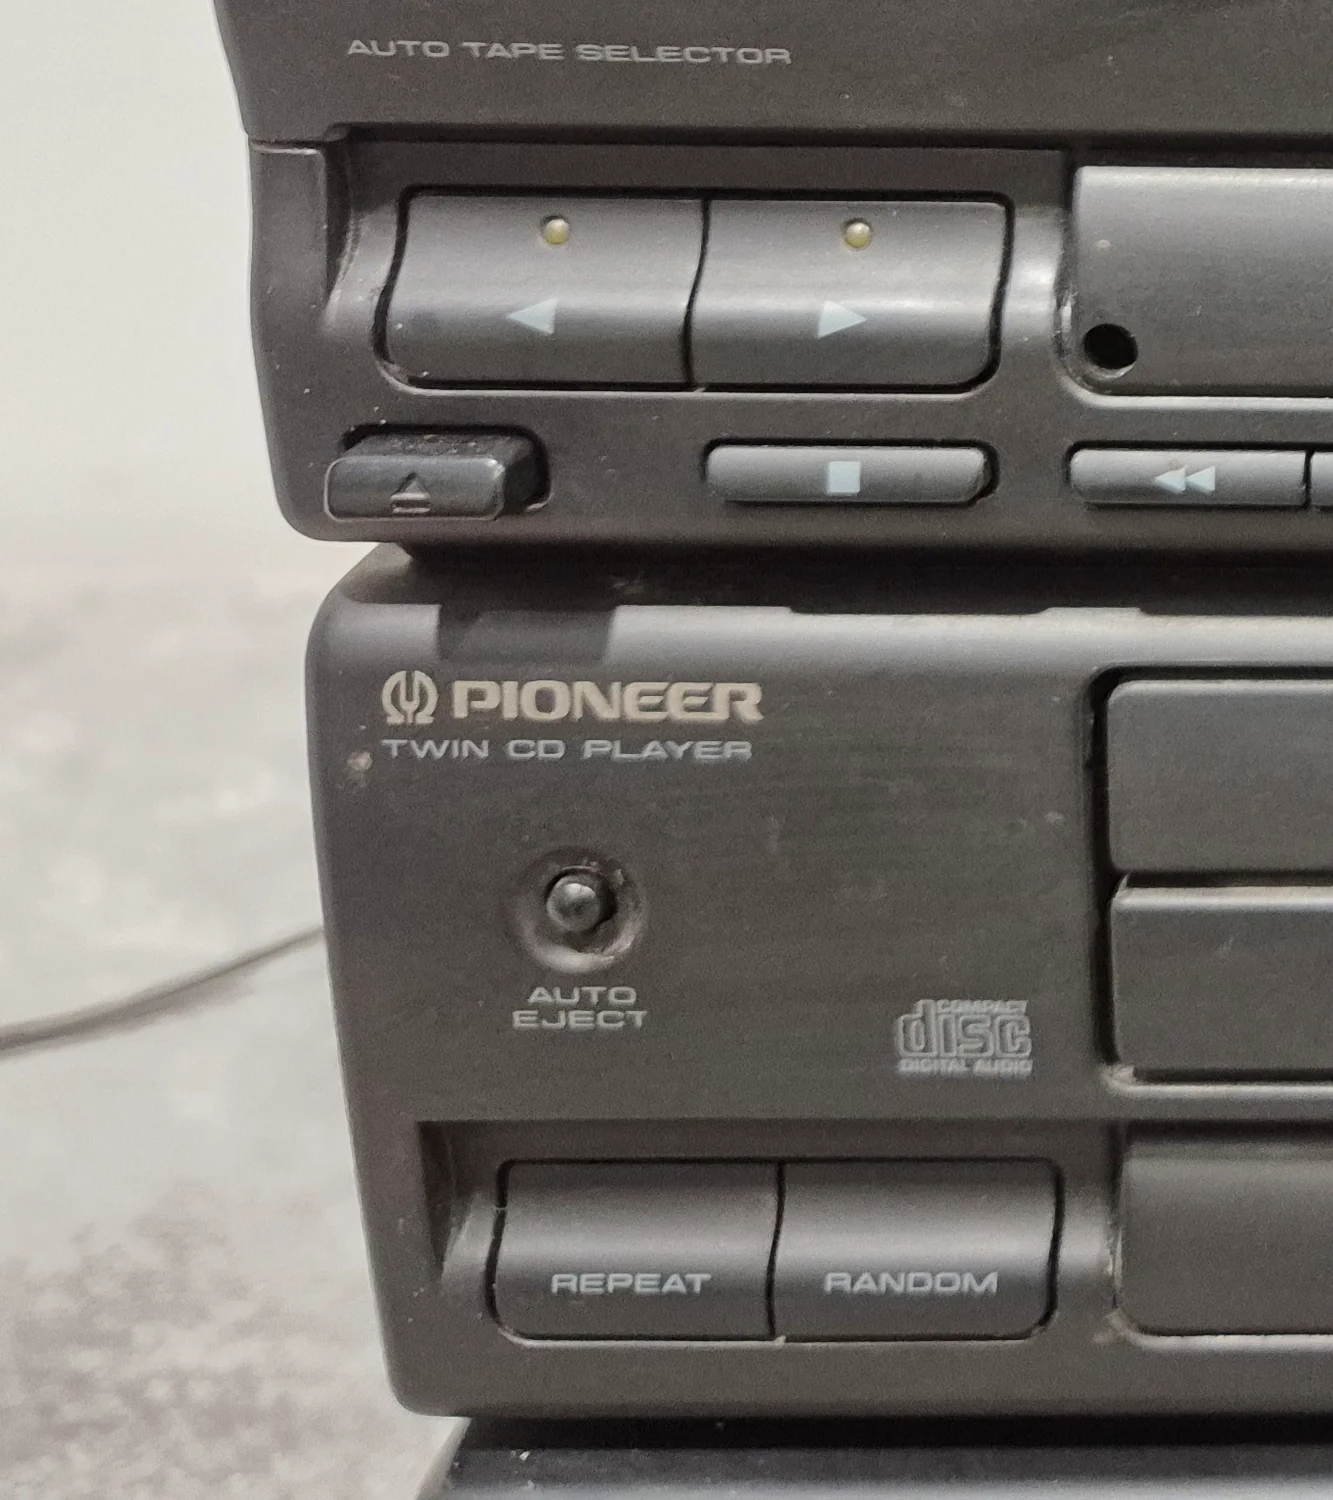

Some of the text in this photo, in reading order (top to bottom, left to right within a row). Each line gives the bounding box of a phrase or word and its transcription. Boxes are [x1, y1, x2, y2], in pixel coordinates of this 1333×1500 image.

[347, 38, 791, 66] AUTO TAPE SELECTOR
[453, 679, 763, 724] PIONEER
[382, 738, 752, 762] TWIN CD PLAYER
[527, 985, 636, 1006] AUTO
[512, 1009, 648, 1031] EJECT
[552, 1272, 711, 1296] REPEAT
[825, 1271, 998, 1296] RANDOM
